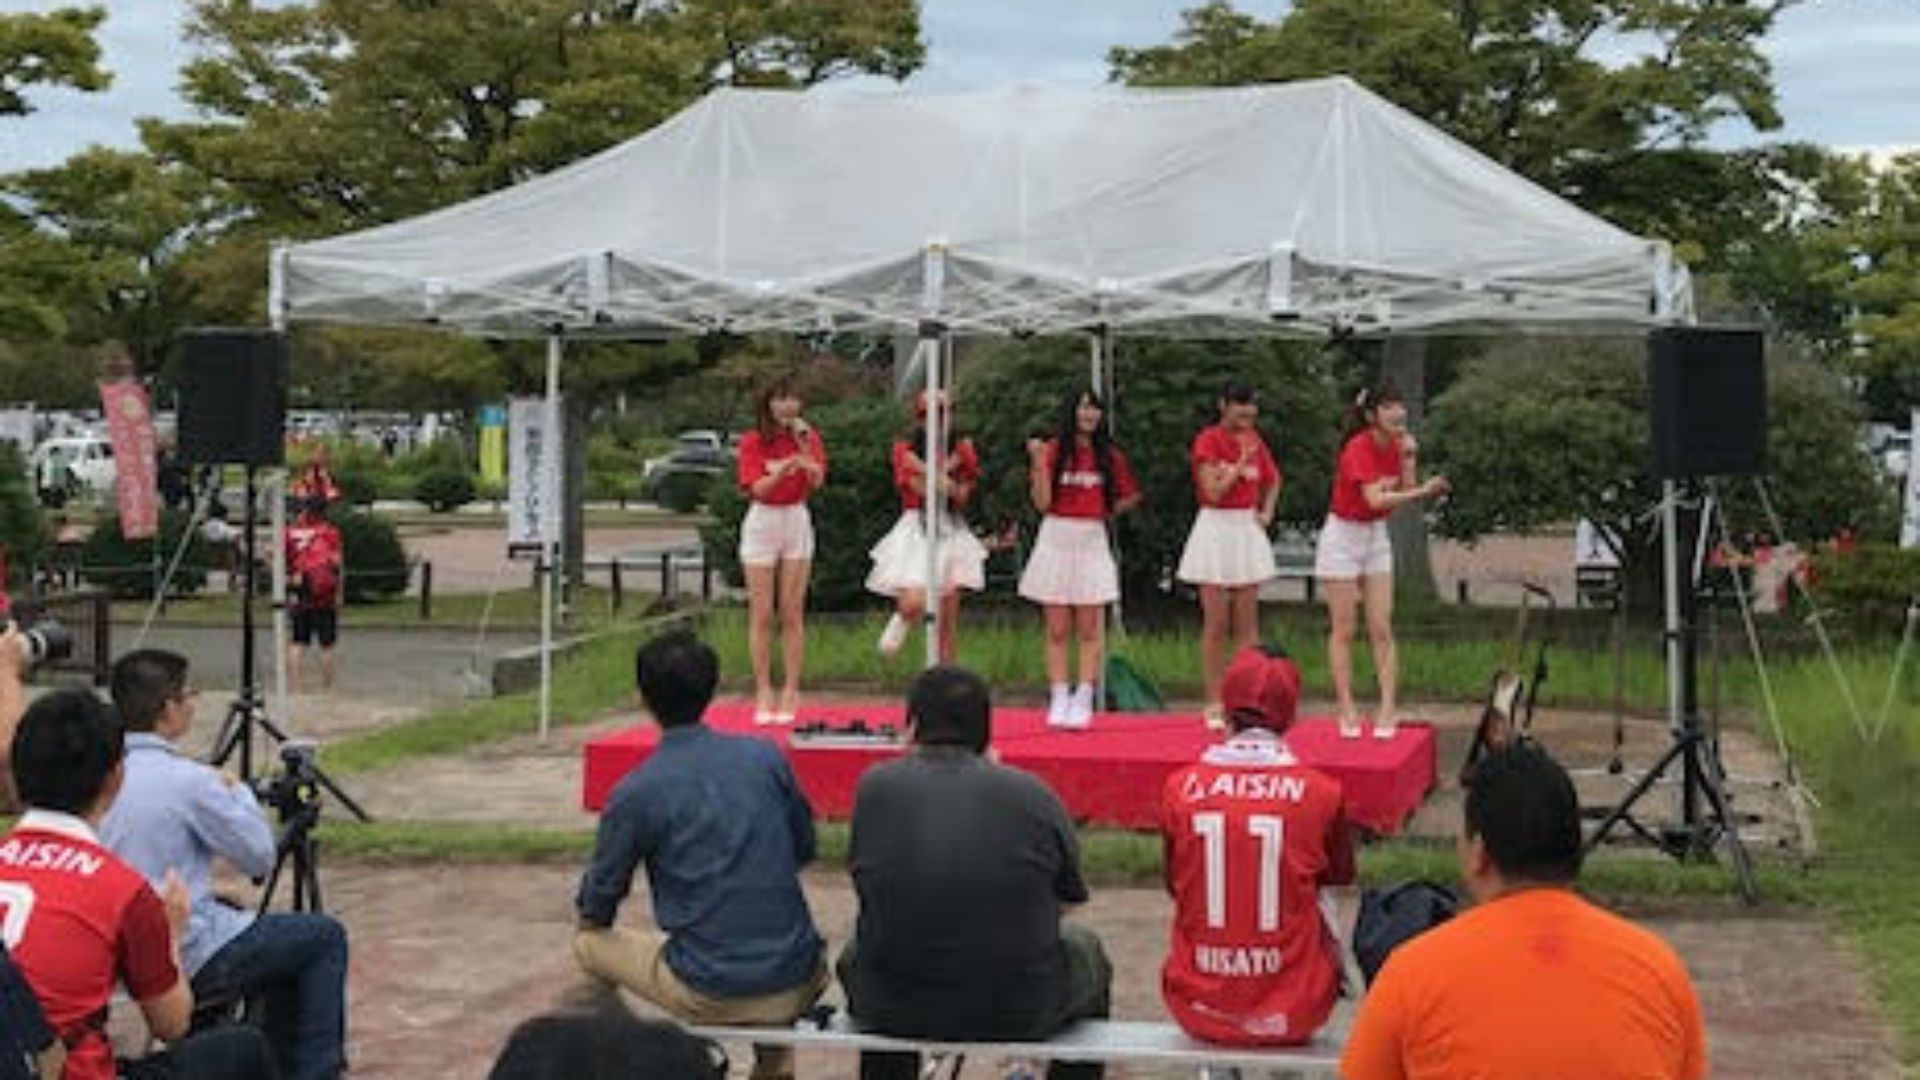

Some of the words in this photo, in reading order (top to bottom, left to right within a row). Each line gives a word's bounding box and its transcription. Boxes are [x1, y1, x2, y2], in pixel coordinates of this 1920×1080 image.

[1209, 773, 1304, 801] AISIN
[0, 839, 104, 876] AISIN
[1191, 811, 1284, 932] 11
[1194, 944, 1282, 977] HISATO
